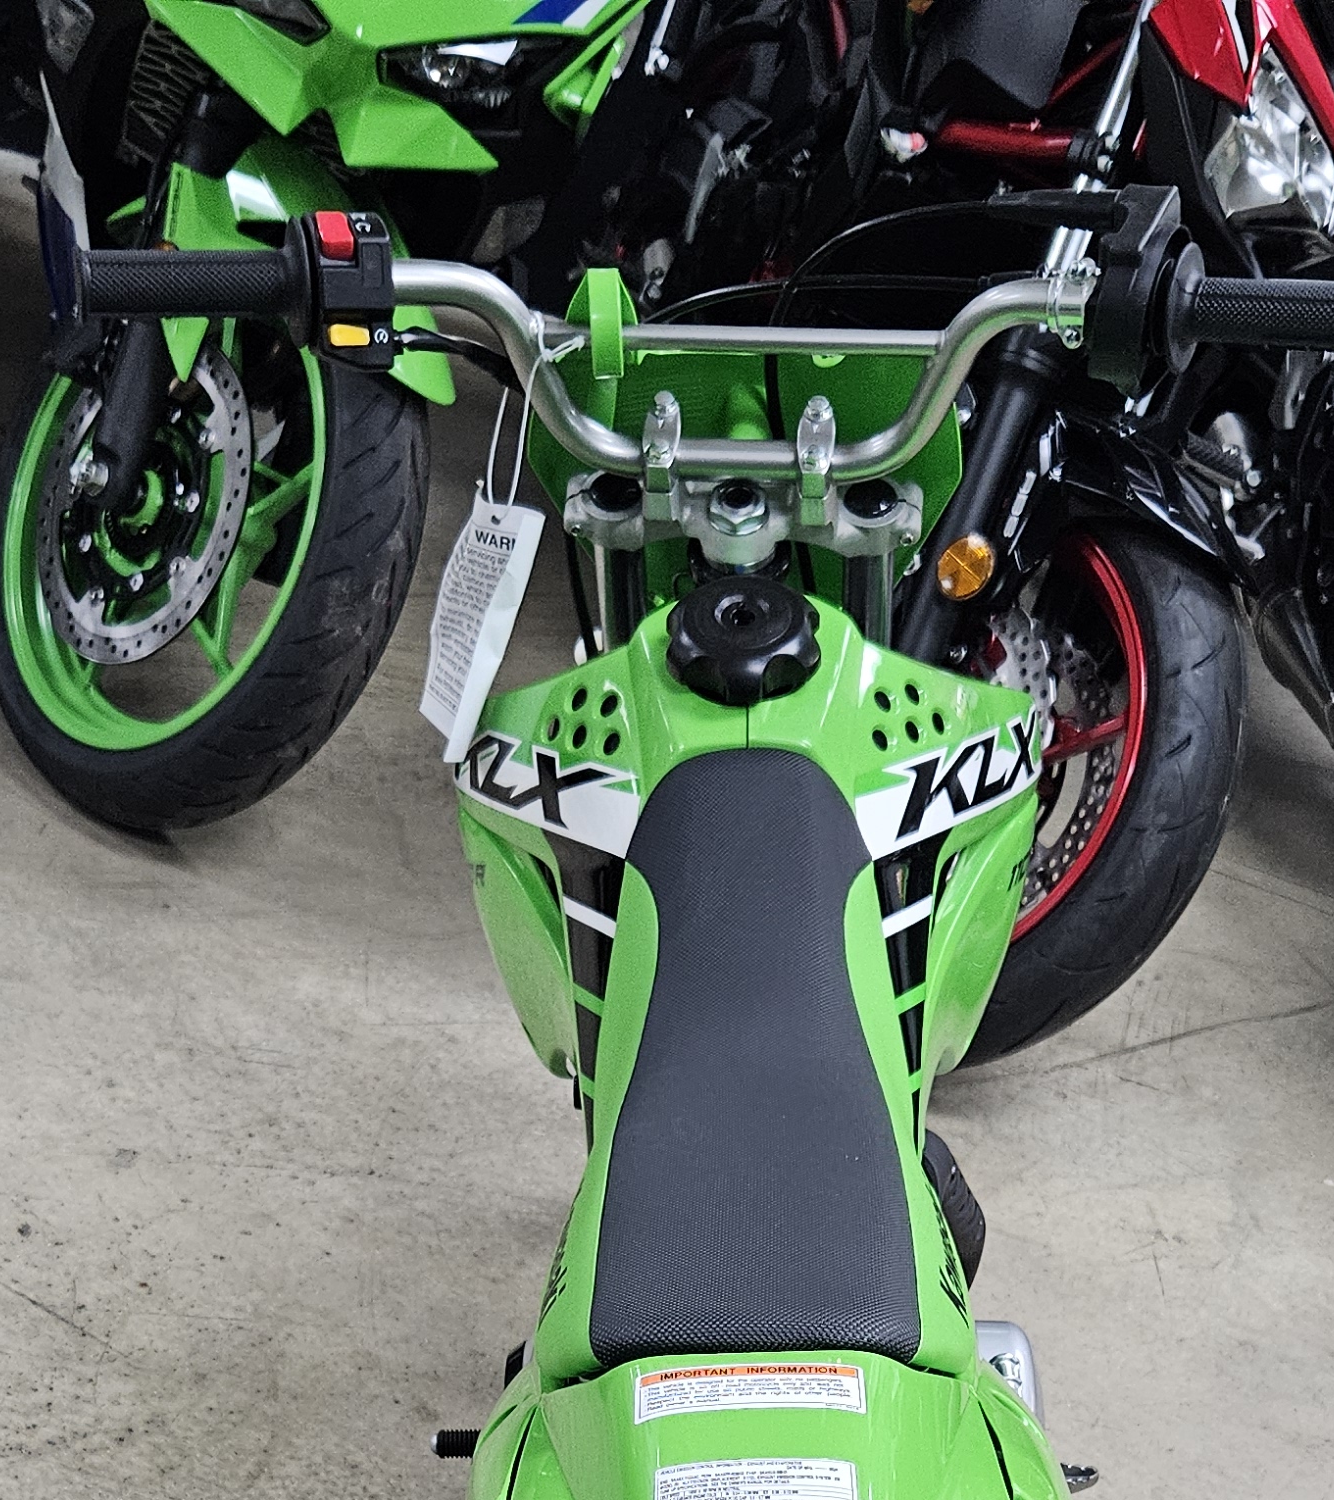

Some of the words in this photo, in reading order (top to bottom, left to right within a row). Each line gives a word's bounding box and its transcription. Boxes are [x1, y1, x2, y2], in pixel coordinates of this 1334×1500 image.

[455, 735, 616, 829] KLX
[894, 710, 1035, 842] KLX
[660, 1368, 735, 1381] IMPORTANT
[747, 1366, 838, 1374] INFORMATION
